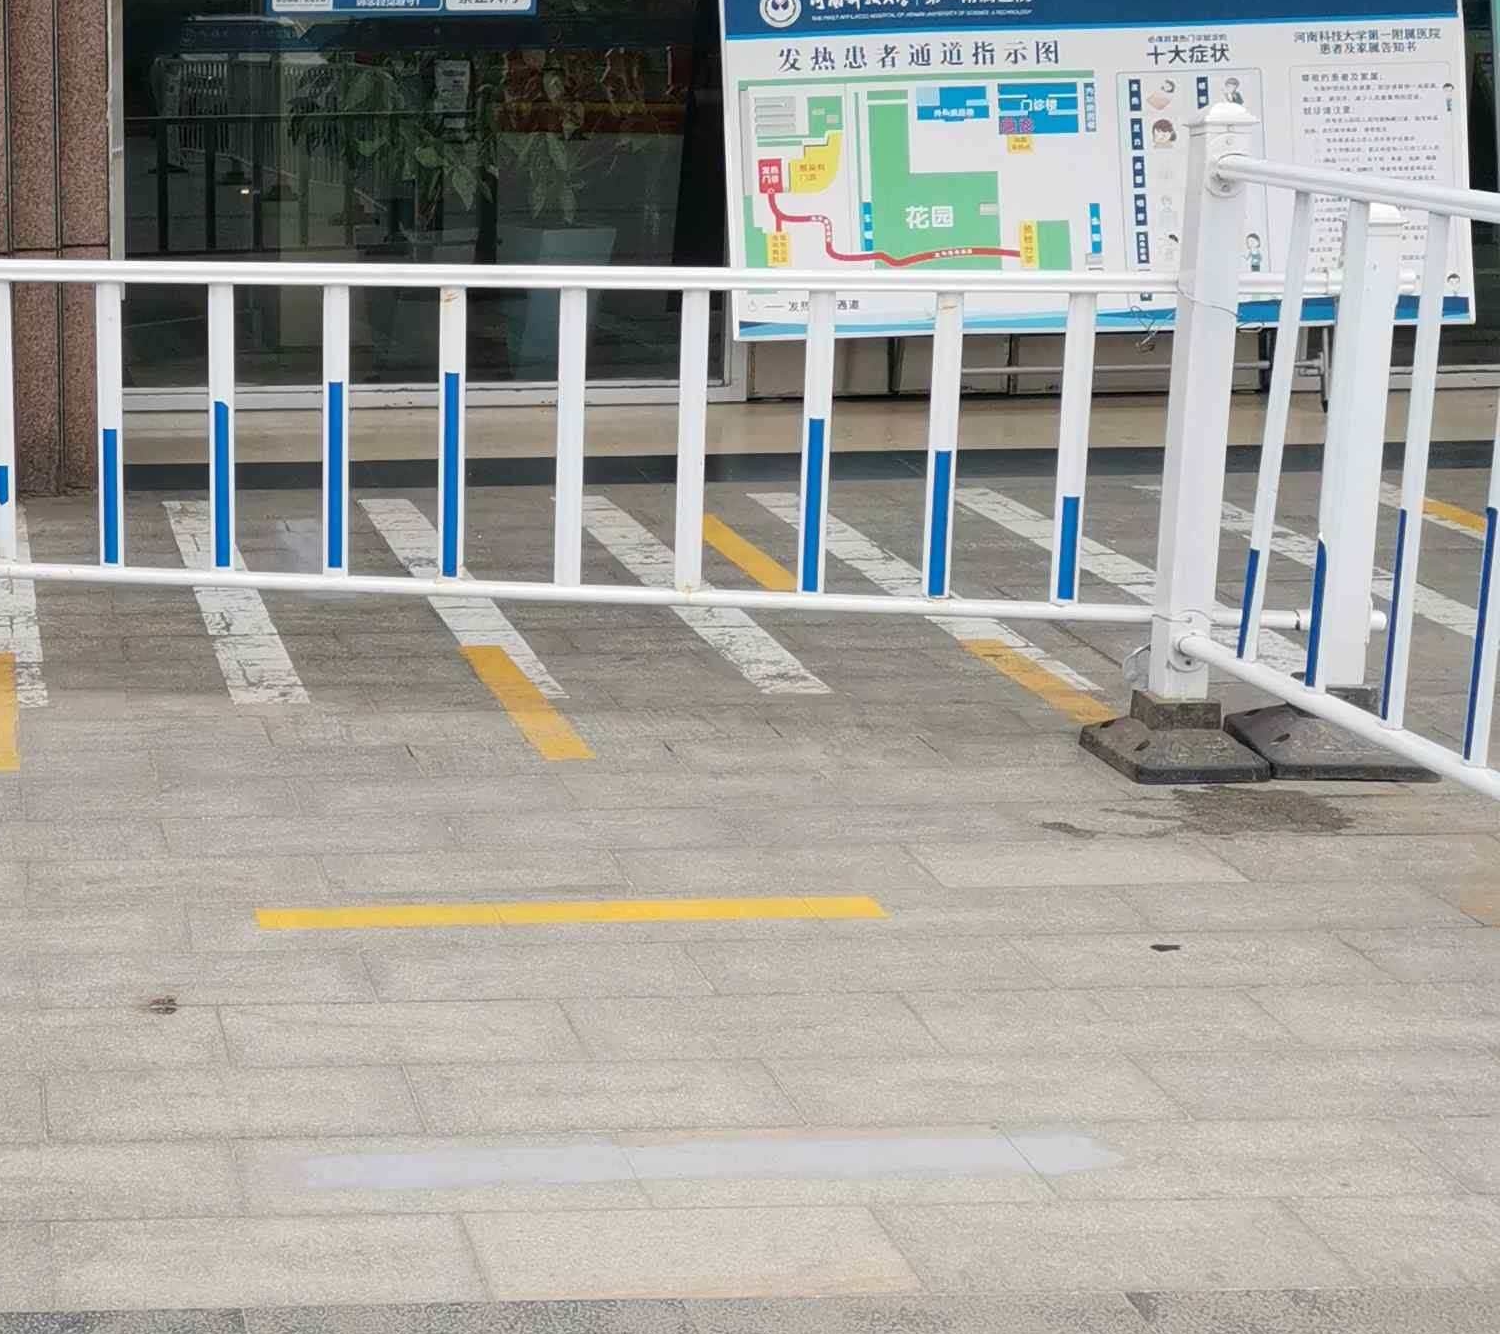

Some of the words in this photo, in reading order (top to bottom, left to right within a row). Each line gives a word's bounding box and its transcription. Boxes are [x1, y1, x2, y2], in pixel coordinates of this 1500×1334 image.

[1294, 28, 1441, 43] 河南科技大学第一附属医院
[778, 40, 1059, 72] 发热患者通道指示图
[1147, 43, 1230, 65] 十大症状
[1320, 41, 1417, 55] 患者及家属告知书
[906, 205, 954, 229] 花园
